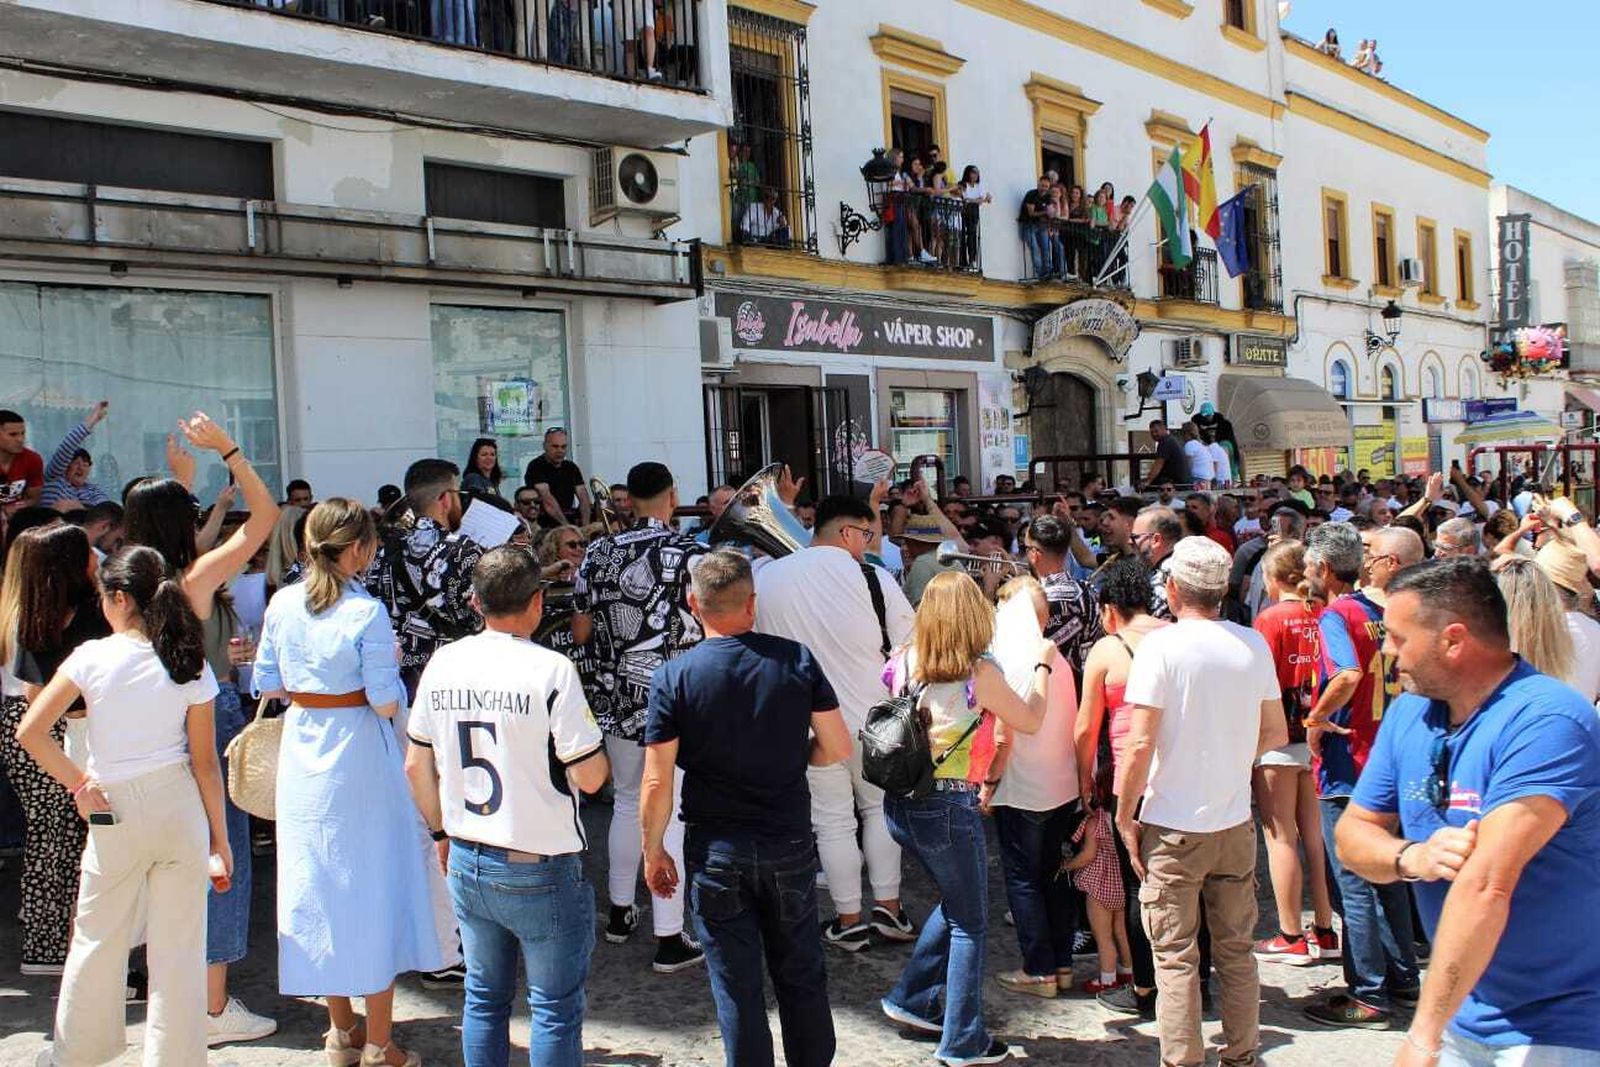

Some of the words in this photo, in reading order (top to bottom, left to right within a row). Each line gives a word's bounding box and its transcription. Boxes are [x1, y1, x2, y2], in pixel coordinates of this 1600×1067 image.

[1503, 221, 1523, 320] HOTEL
[783, 301, 863, 352] Isabella
[883, 317, 934, 346] VÁPER
[936, 325, 975, 348] SHOP
[431, 689, 531, 715] BELLINGHAM
[457, 720, 503, 816] 5
